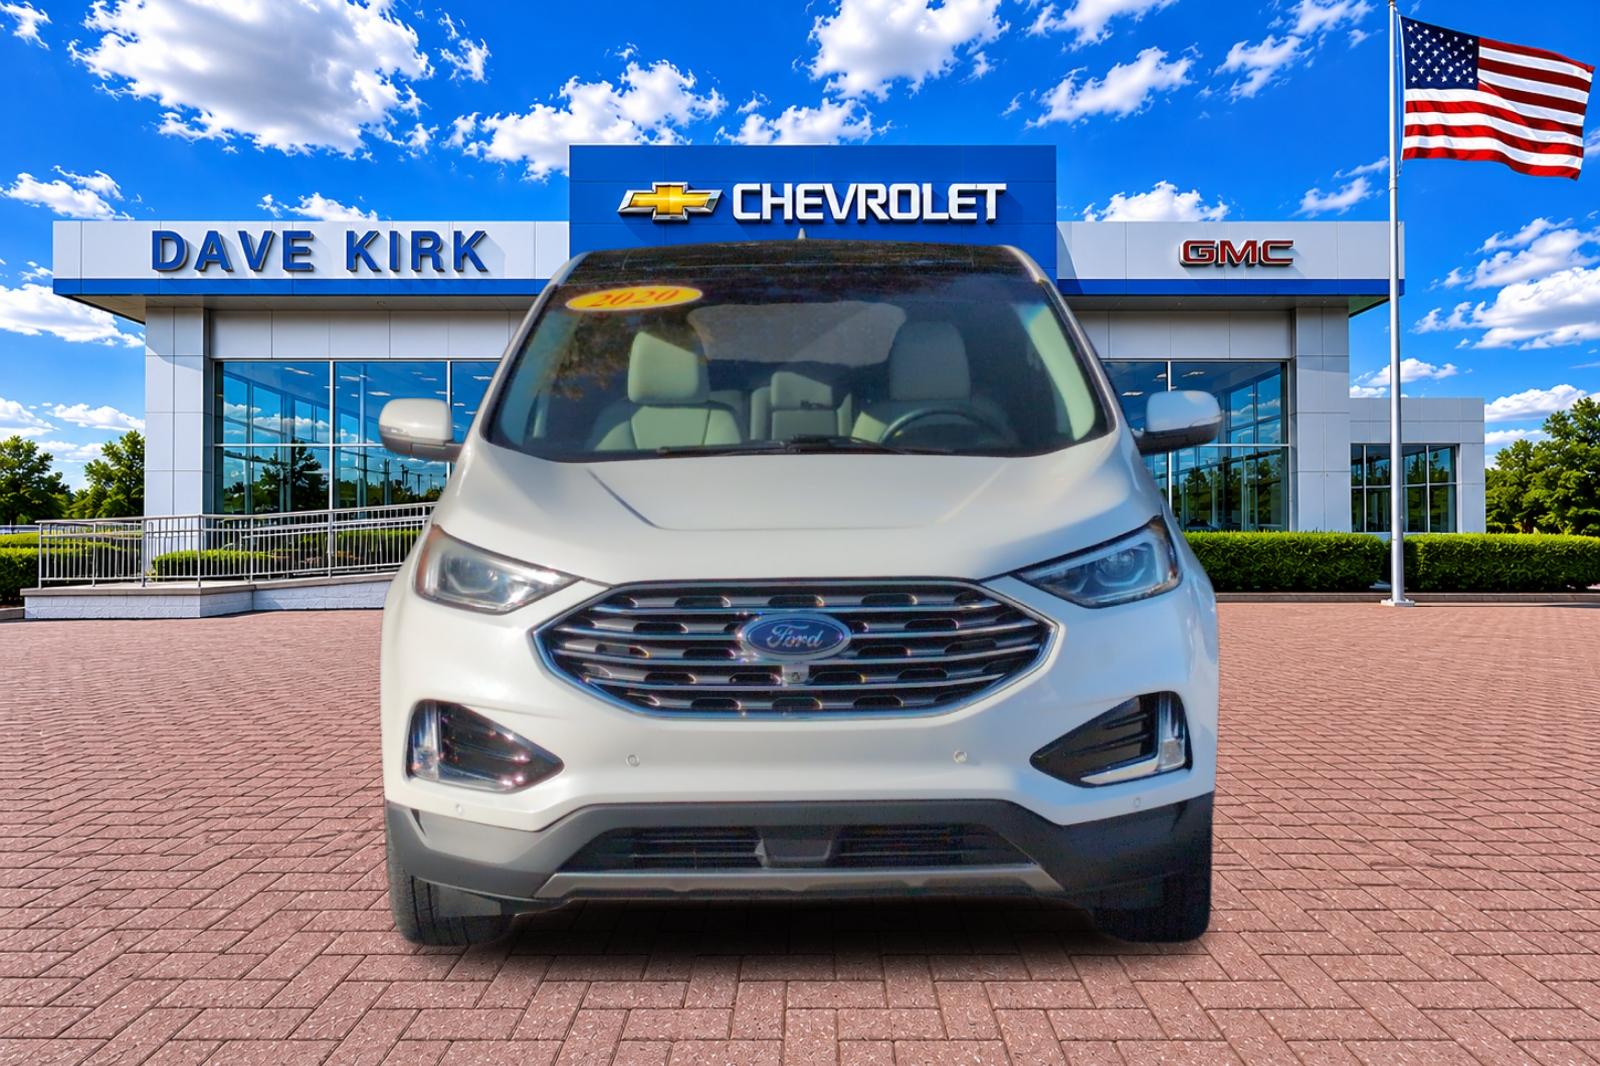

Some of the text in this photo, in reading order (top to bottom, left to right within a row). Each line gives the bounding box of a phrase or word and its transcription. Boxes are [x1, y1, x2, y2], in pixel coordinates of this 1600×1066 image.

[732, 183, 1006, 222] CHEVROLET
[151, 230, 488, 272] DAVE KIRK
[1179, 239, 1295, 266] GMC
[586, 288, 681, 308] 2020
[765, 623, 825, 649] Ford
